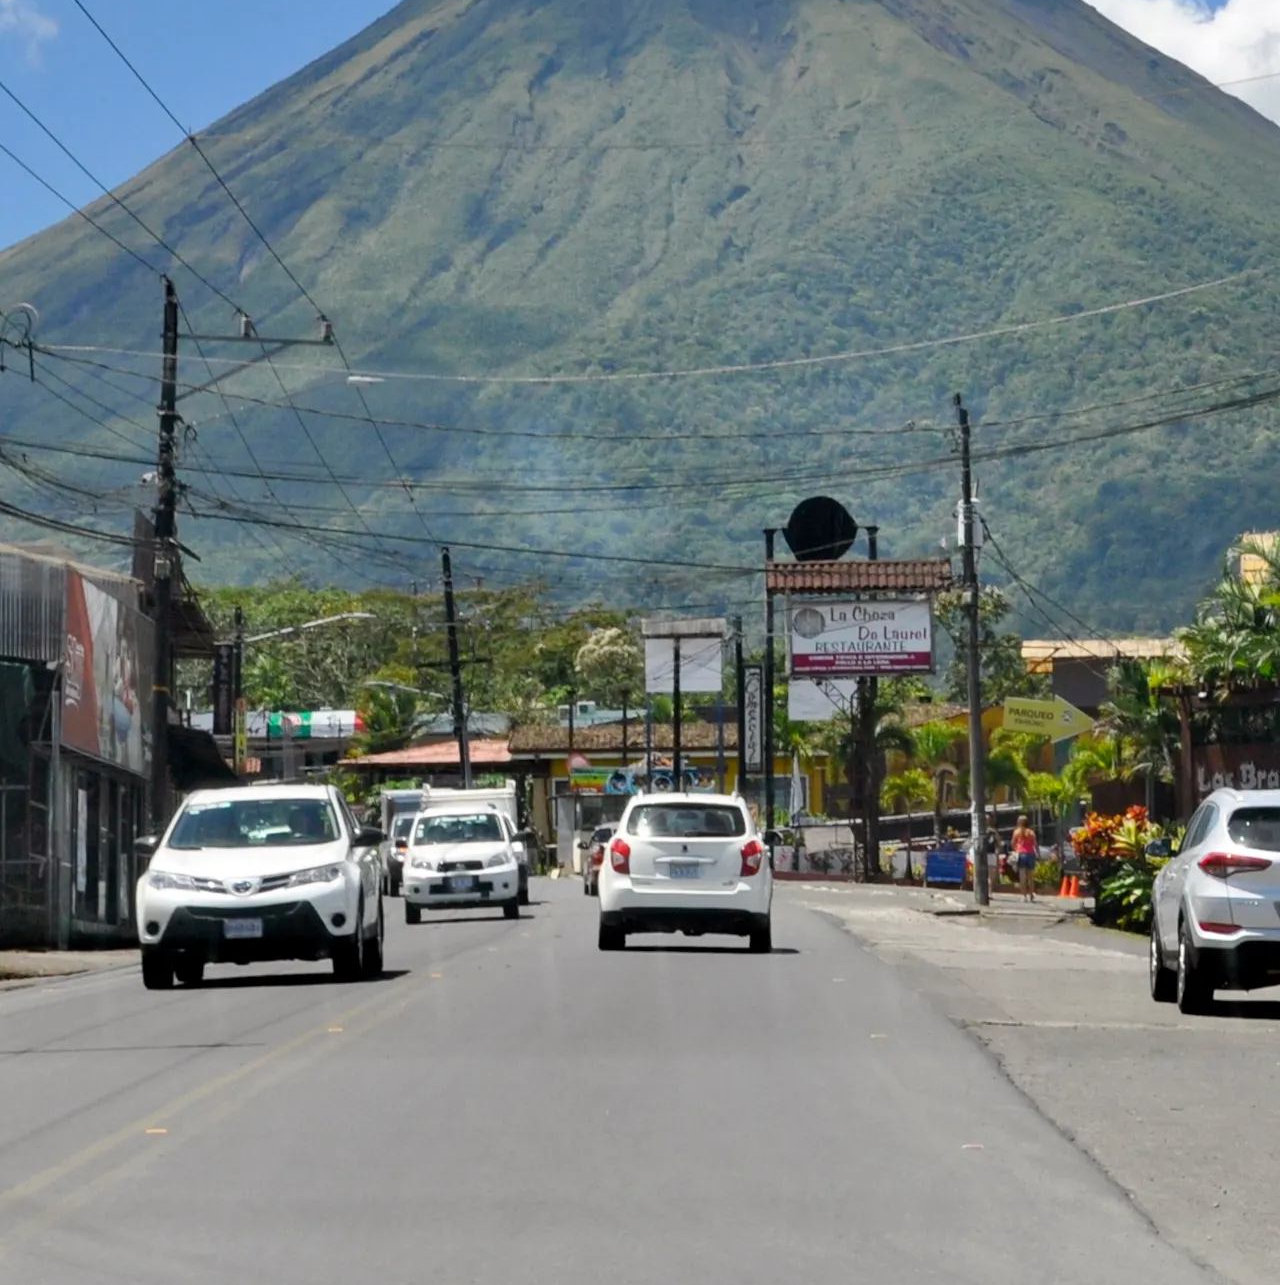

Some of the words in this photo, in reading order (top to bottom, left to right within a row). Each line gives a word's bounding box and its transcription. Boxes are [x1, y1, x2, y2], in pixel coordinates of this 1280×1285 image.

[830, 607, 847, 622] La
[852, 605, 895, 622] Choza
[815, 641, 906, 654] RESTAURANTE
[1008, 707, 1054, 721] PARQUEO
